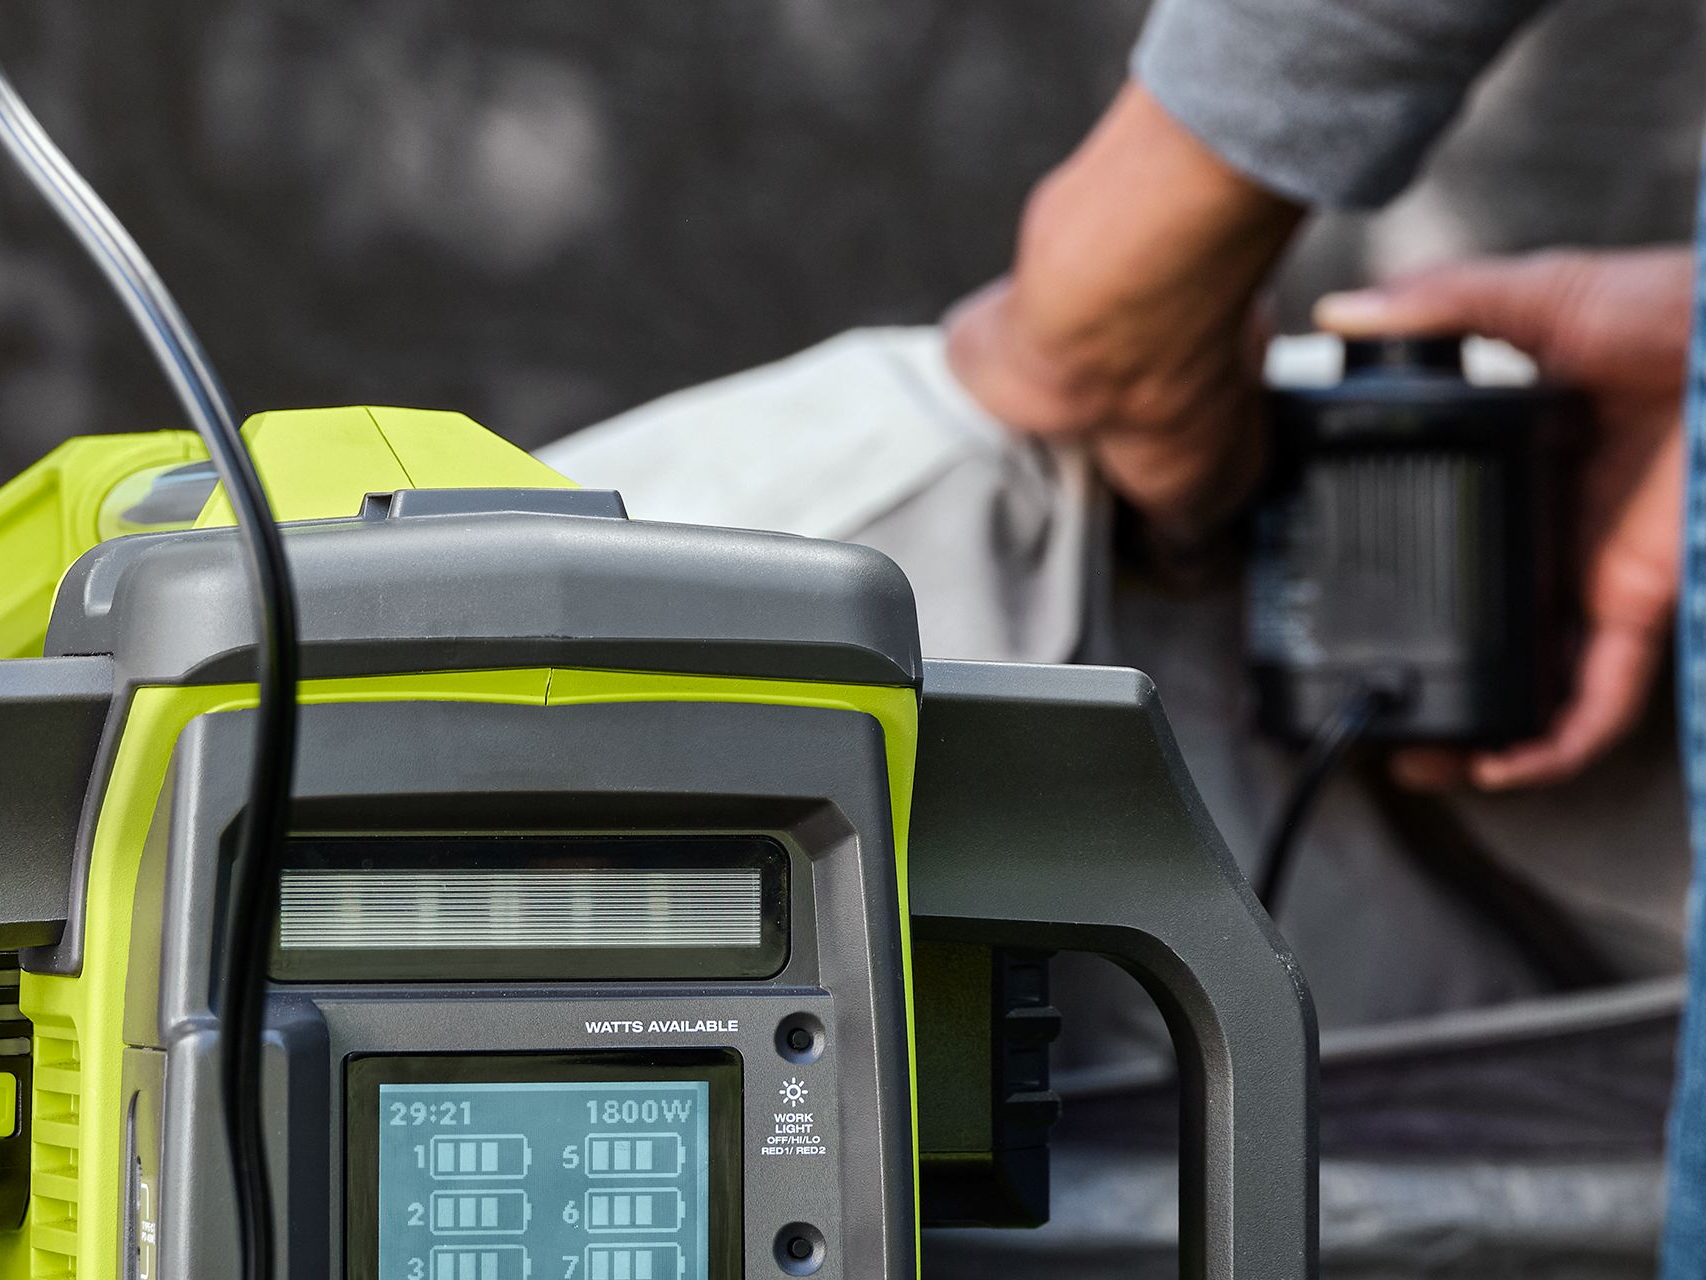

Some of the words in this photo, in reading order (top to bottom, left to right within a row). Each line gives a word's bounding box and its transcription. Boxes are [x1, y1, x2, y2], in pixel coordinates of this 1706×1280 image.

[585, 1021, 643, 1033] WATTS
[648, 1020, 738, 1032] AVAILABLE
[390, 1101, 471, 1126] 29:21
[587, 1099, 692, 1124] 1800W
[774, 1113, 813, 1122] WORK
[767, 1135, 821, 1144] OFF/HI/LO
[775, 1124, 813, 1133] LIGHT
[413, 1145, 425, 1168] 1
[562, 1145, 580, 1169] 5
[761, 1147, 793, 1155] RED1/
[796, 1146, 826, 1155] RED2
[407, 1202, 425, 1226] 2
[562, 1200, 580, 1224] 6
[407, 1257, 425, 1280] 3
[562, 1255, 580, 1279] 7
